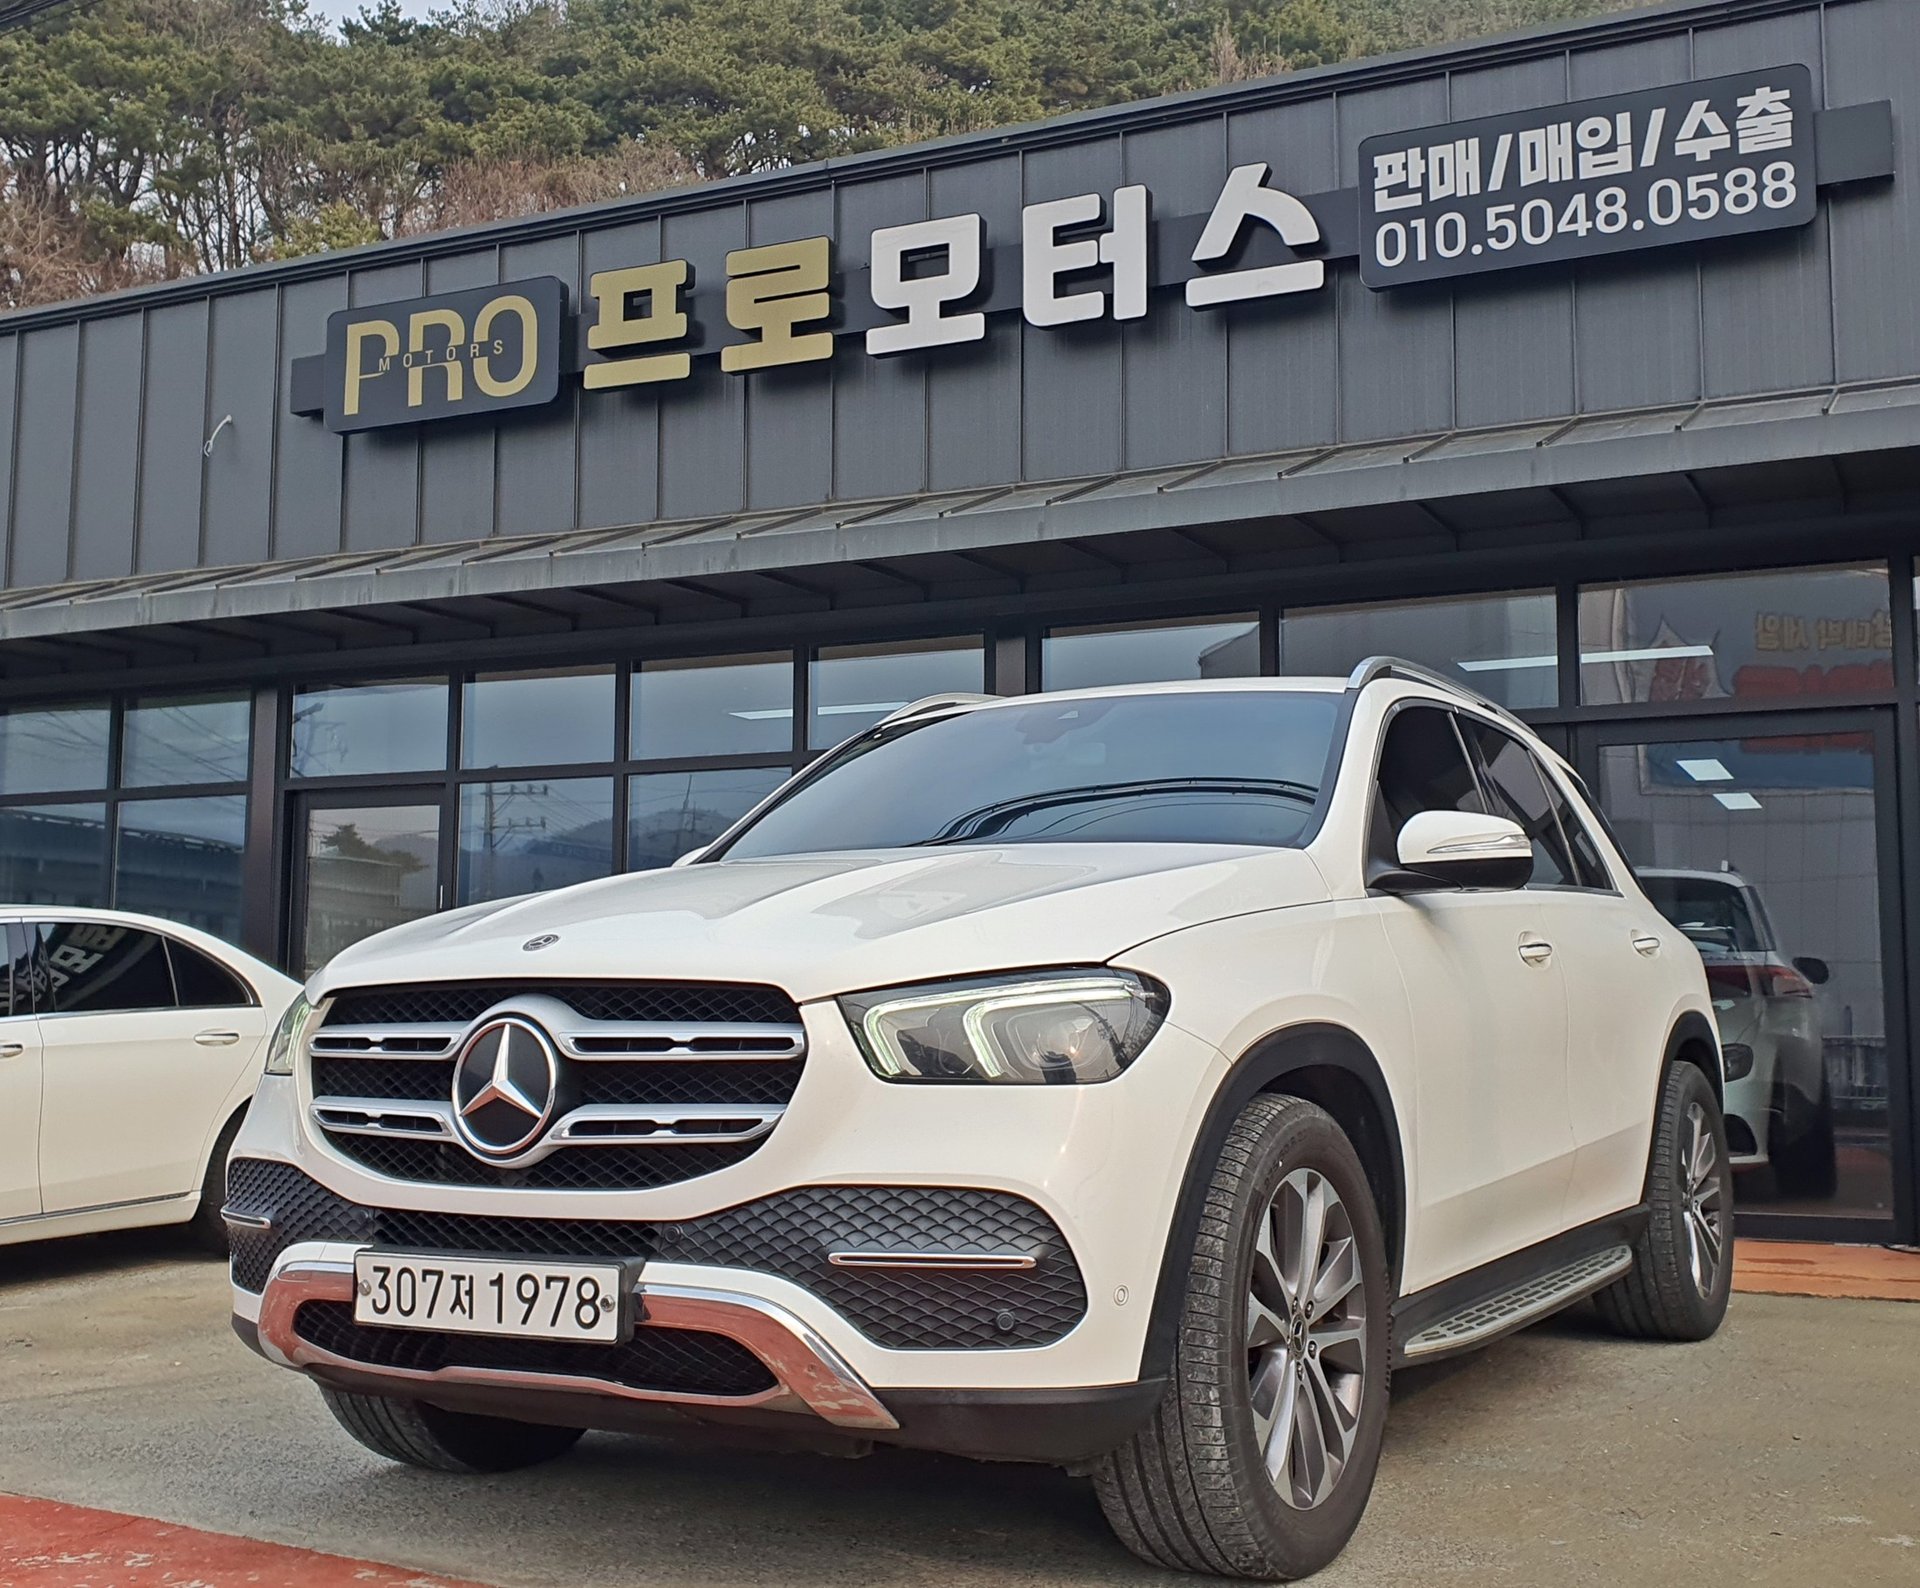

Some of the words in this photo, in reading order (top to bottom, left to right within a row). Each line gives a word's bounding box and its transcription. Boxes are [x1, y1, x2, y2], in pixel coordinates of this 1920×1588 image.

[1373, 86, 1794, 213] 판매/매입/수출
[1374, 160, 1797, 268] 010.5048.0588
[343, 294, 539, 416] PRO
[378, 339, 504, 372] MOTORS
